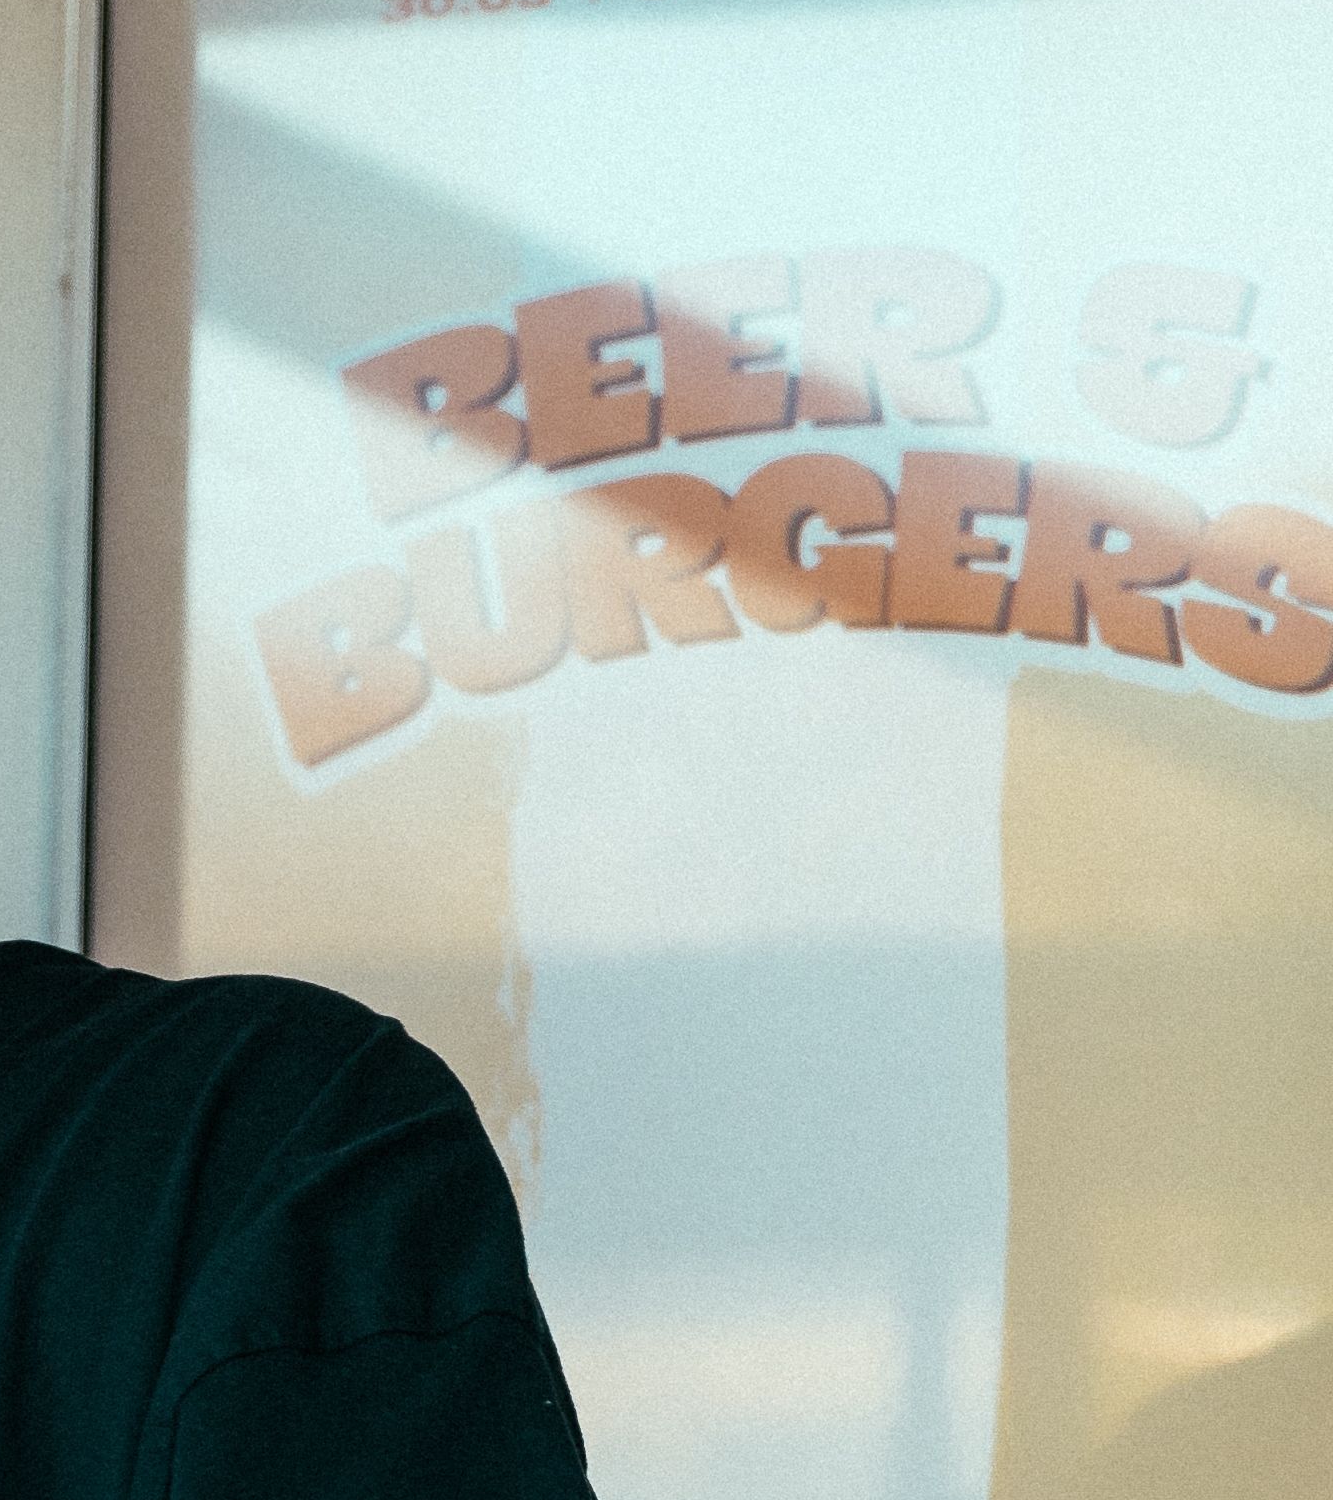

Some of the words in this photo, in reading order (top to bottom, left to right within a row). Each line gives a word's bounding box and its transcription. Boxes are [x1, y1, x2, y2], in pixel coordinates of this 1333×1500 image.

[339, 246, 1005, 526] BEER
[1073, 261, 1273, 450] &
[252, 450, 1333, 770] BURGERS
